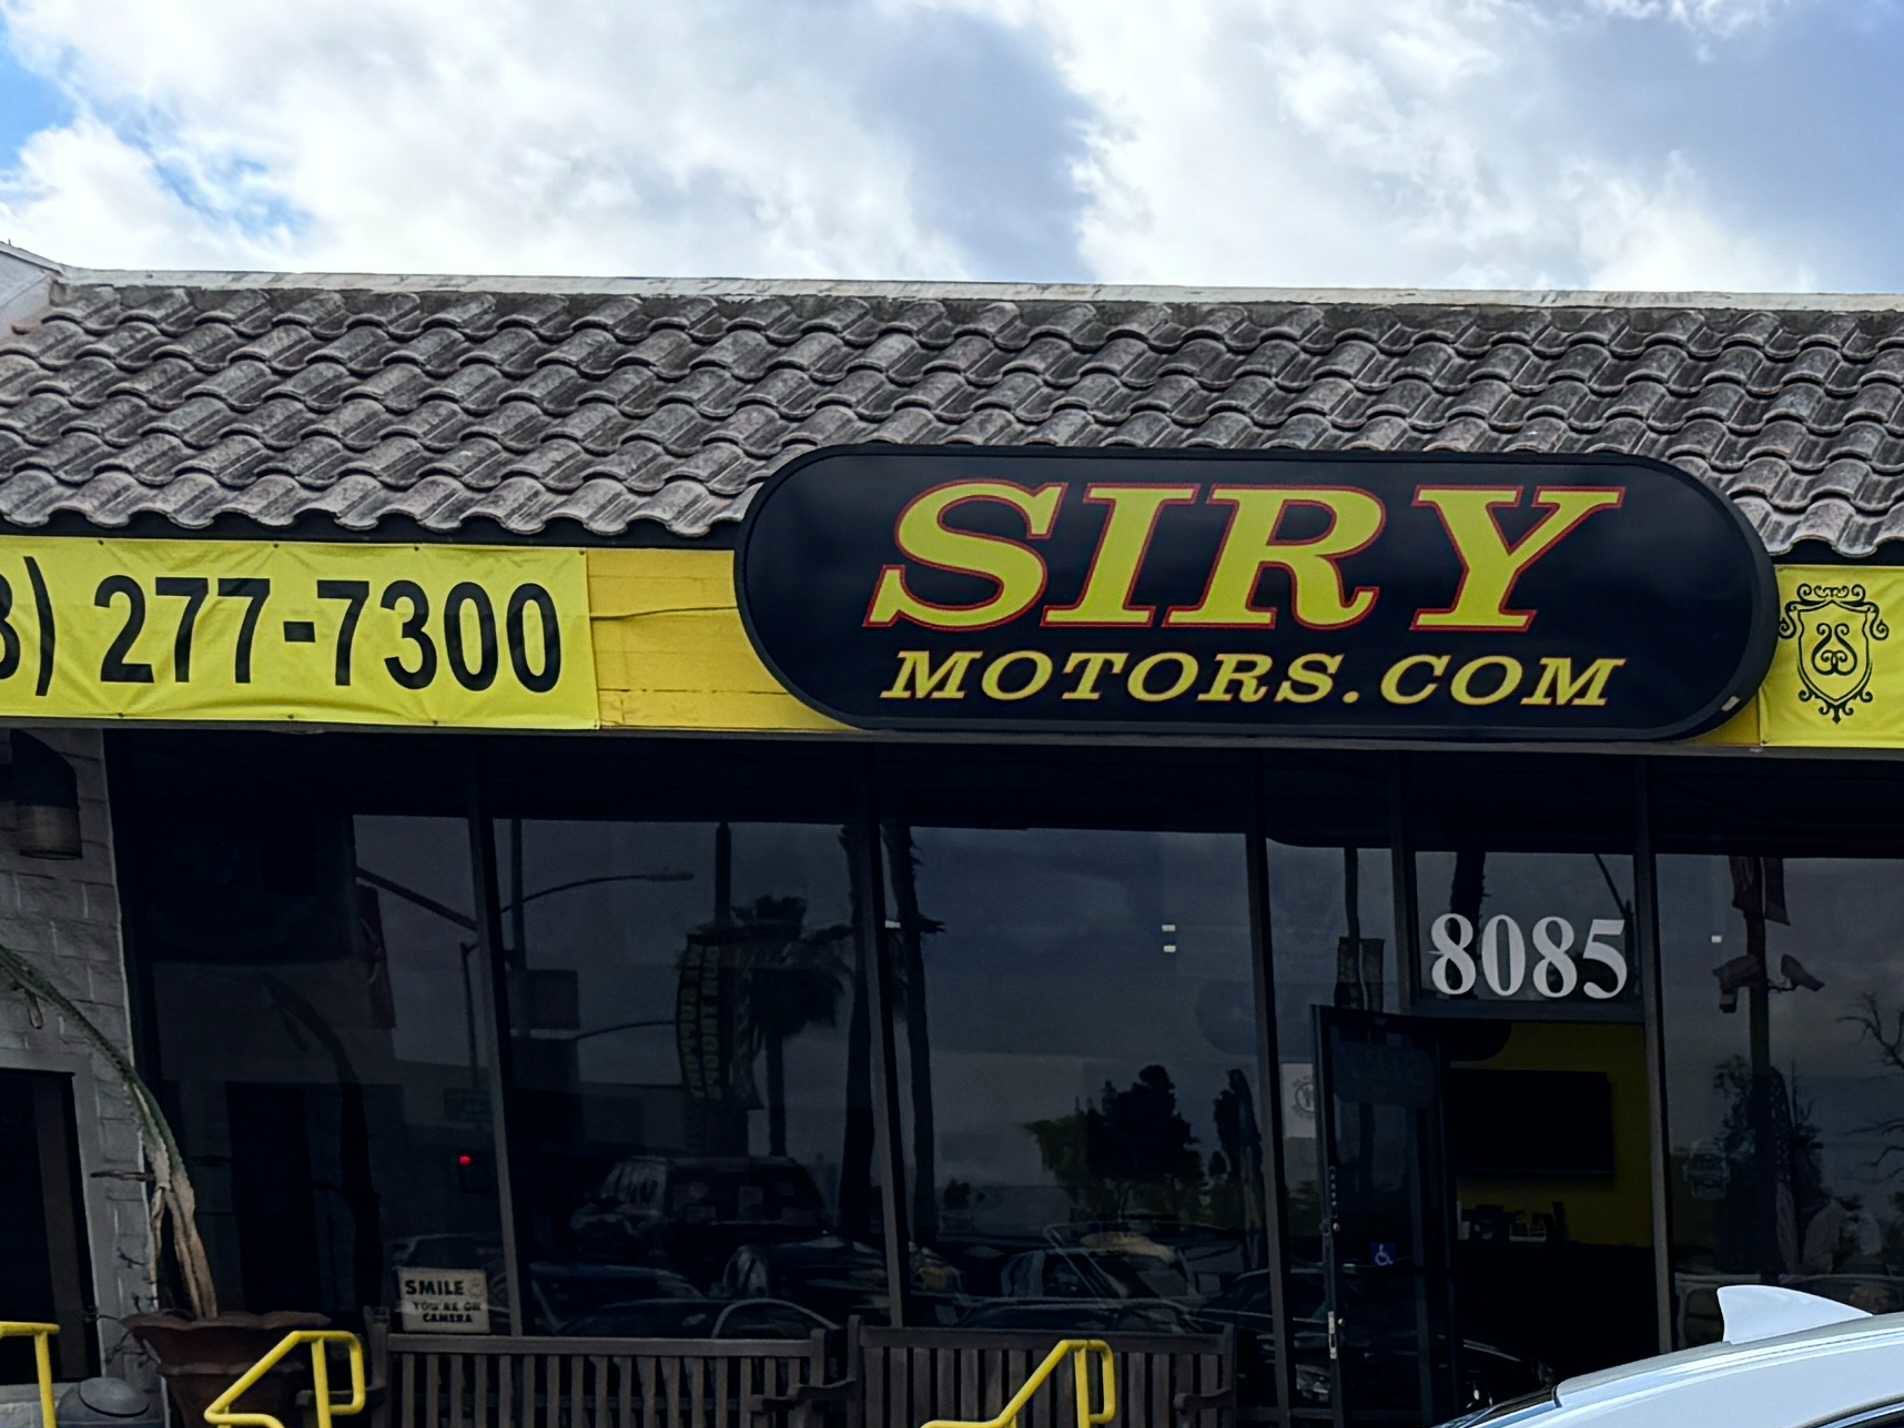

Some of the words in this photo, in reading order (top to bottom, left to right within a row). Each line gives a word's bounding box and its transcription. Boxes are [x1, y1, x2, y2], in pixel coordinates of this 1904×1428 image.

[862, 478, 1626, 632] SIRY
[93, 574, 563, 694] 277-7300
[880, 649, 1626, 708] MOTORS.COM
[1429, 913, 1628, 999] 8085
[405, 1280, 464, 1295] SMILE
[423, 1313, 472, 1323] CAMERA
